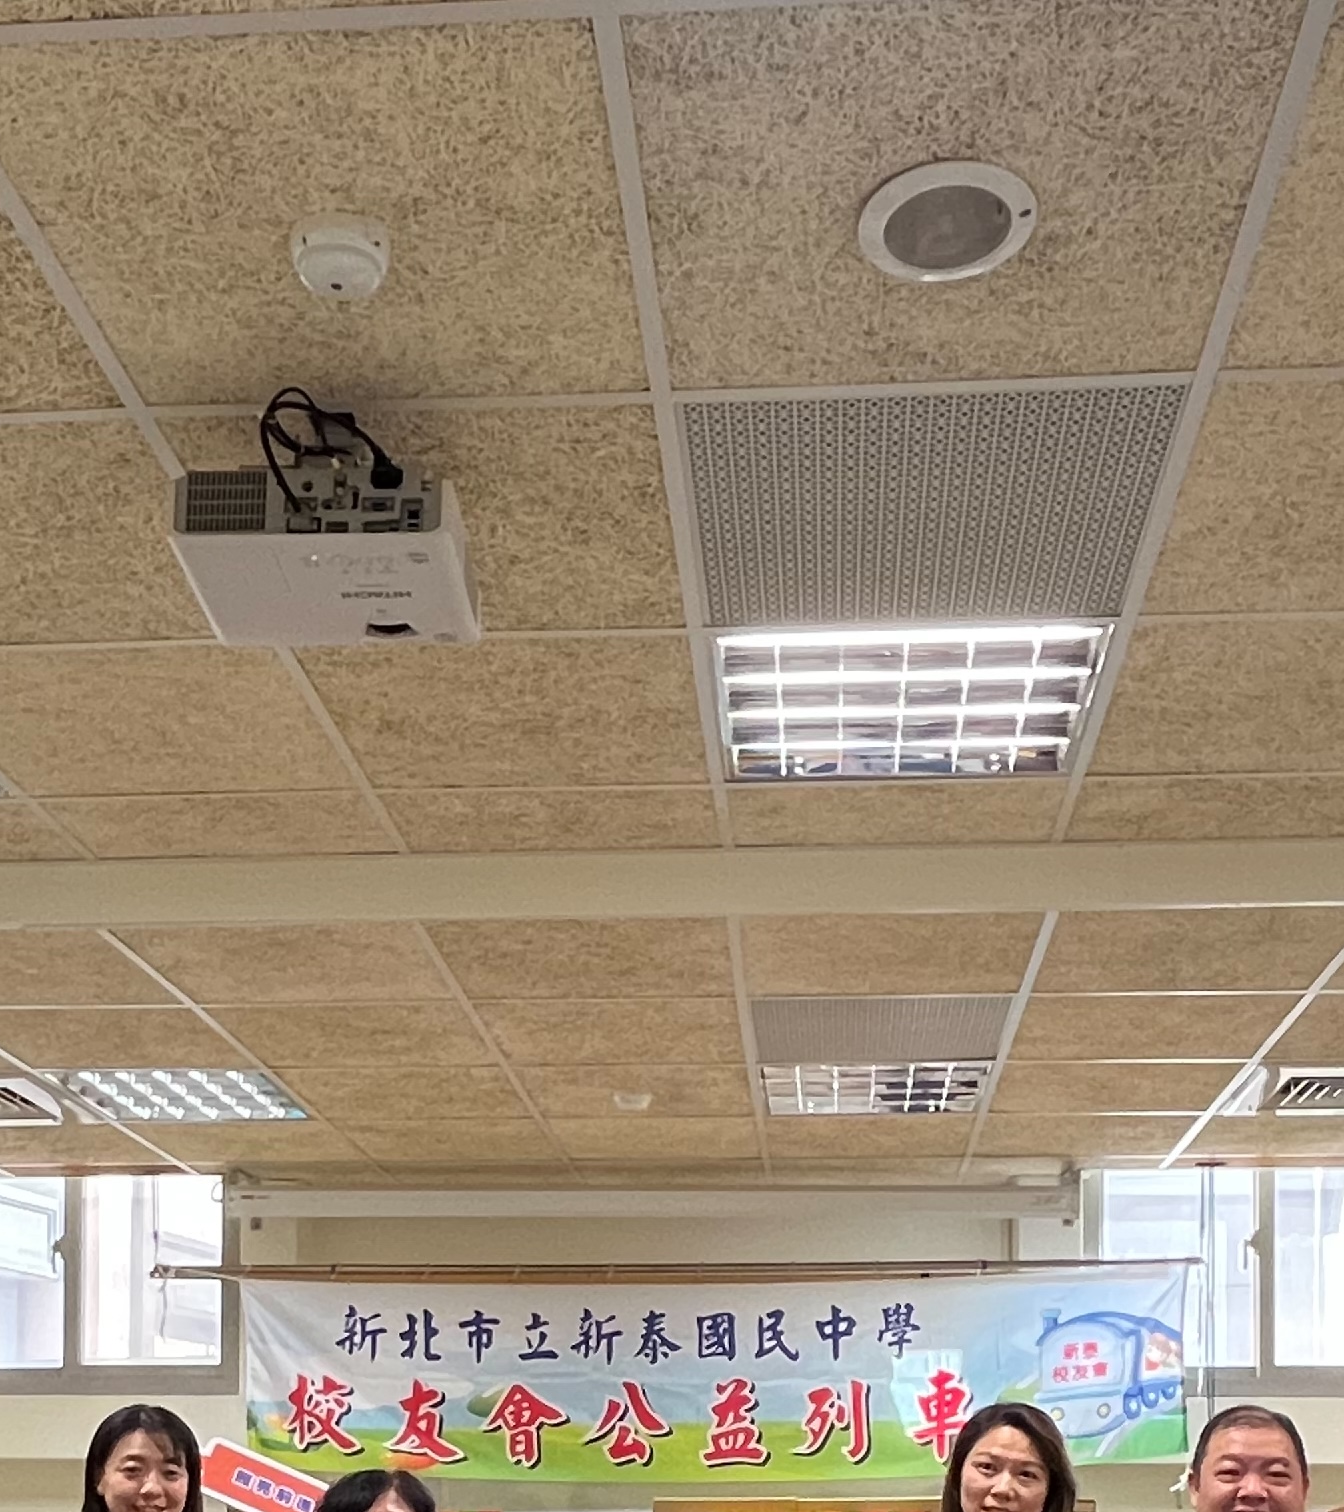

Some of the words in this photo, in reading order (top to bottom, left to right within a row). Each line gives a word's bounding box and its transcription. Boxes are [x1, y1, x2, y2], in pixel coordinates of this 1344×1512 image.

[334, 1303, 921, 1366] 新北市立新泰國民中學
[284, 1368, 972, 1466] 校友會公益列車
